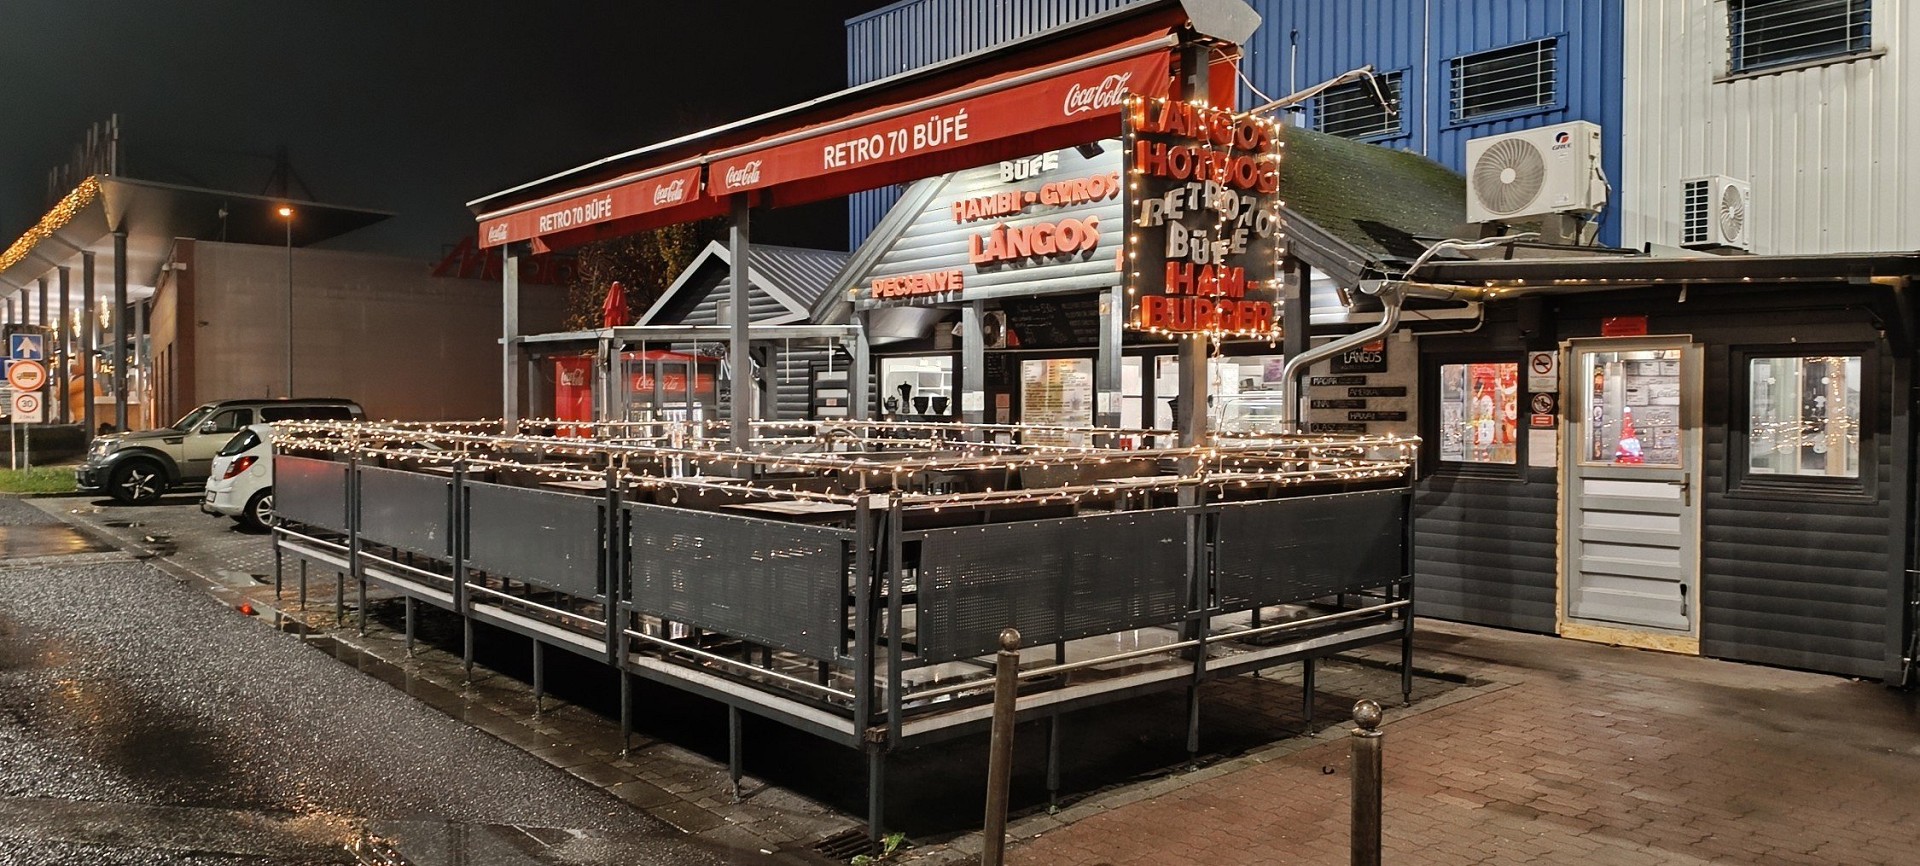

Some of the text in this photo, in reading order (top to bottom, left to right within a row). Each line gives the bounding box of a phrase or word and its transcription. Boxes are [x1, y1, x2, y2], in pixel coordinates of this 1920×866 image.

[1064, 71, 1133, 117] Coca-Cola
[823, 108, 969, 170] RETRO 70 BÜFÉ
[1551, 143, 1572, 151] GREE
[725, 159, 763, 189] Coca-Cola
[1136, 140, 1277, 194] HOTDOG
[653, 178, 686, 206] Coca-Cola
[951, 190, 1022, 225] HAMBI
[1040, 170, 1121, 207] GYROS
[539, 194, 613, 233] RETRO 70 BÜFÉ
[871, 269, 964, 299] PECSENYE
[1141, 295, 1274, 332] BURGER
[21, 399, 33, 408] 30
